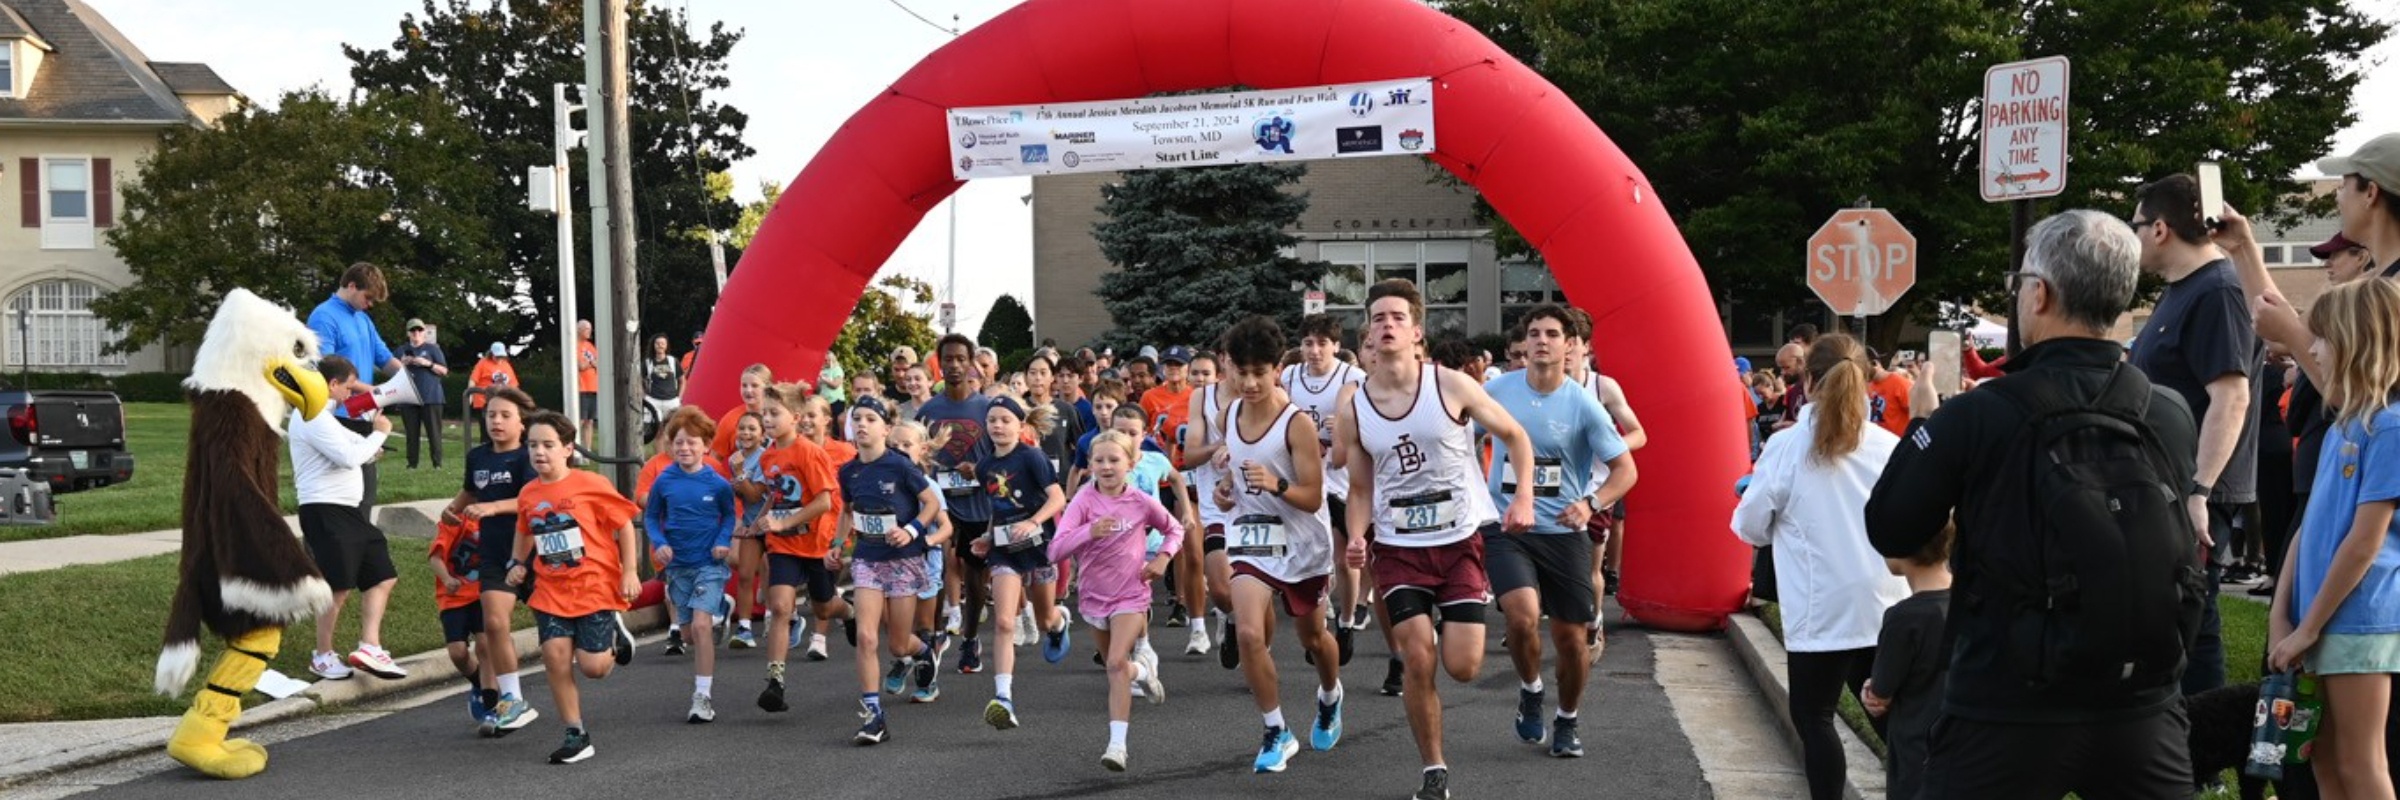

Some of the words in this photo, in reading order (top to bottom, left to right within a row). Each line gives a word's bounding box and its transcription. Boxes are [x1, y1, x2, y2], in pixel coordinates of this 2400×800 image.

[2011, 70, 2040, 96] NO
[1057, 109, 1086, 118] Annual
[1088, 108, 1117, 118] Jessica
[1120, 104, 1157, 115] Meredith
[1159, 103, 1197, 113] Jacobsen
[1201, 99, 1241, 110] Memorial
[1244, 99, 1255, 108] 5K
[1257, 98, 1276, 107] Run
[1277, 95, 1294, 105] and
[1297, 94, 1315, 104] Fun
[1317, 92, 1338, 101] Walk
[1989, 96, 2060, 128] PARKING
[1132, 118, 1190, 132] September
[1193, 117, 1209, 128] 21,
[1213, 116, 1240, 127] 2024
[1054, 132, 1095, 140] MARINER
[1151, 134, 1197, 145] Towson,
[1200, 131, 1222, 142] MD
[2010, 127, 2038, 146] ANY
[1155, 151, 1187, 162] Start
[1191, 150, 1220, 161] Line
[2009, 148, 2038, 166] TIME
[1815, 244, 1907, 282] STOP
[861, 515, 883, 533] 168
[1406, 505, 1437, 528] 237
[541, 532, 568, 554] 200
[1240, 525, 1270, 545] 217
